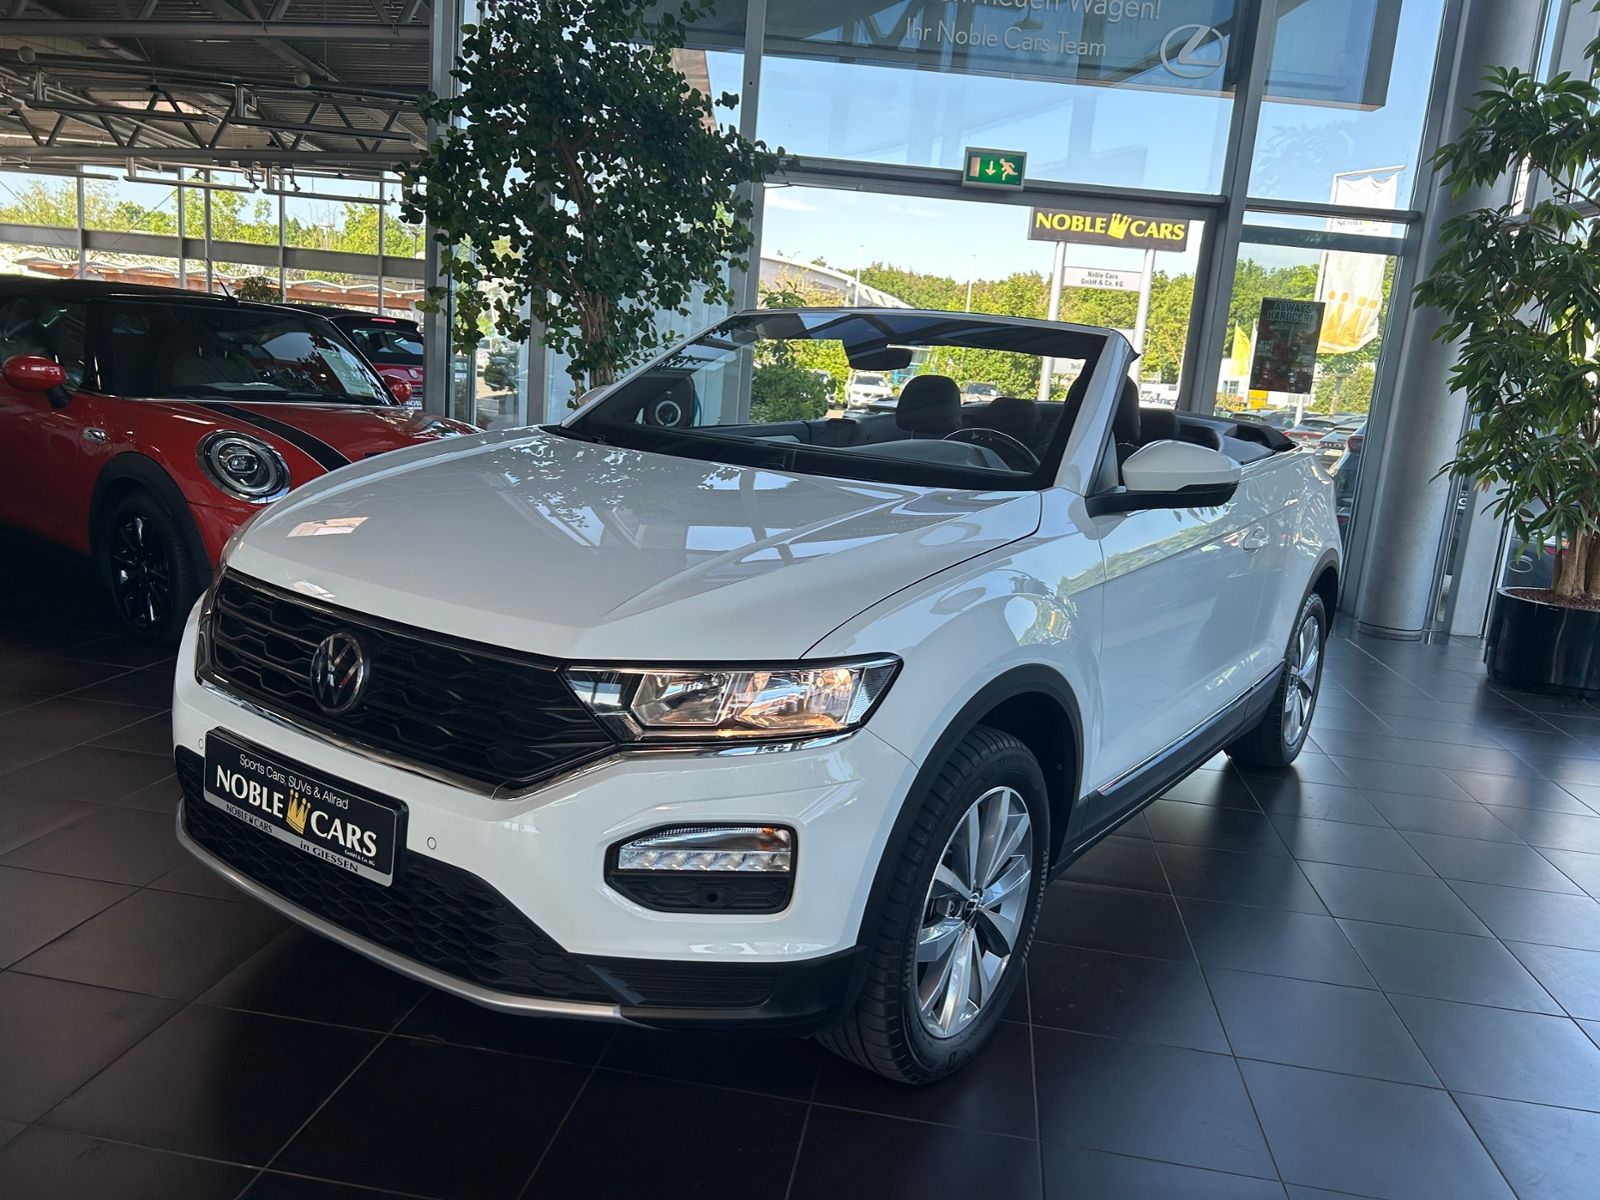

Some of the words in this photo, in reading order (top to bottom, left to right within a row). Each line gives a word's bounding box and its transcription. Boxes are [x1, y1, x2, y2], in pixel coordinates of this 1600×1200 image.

[906, 17, 931, 42] Ihr
[937, 22, 998, 48] Noble
[1004, 26, 1049, 52] Cars
[1057, 31, 1107, 57] Team
[1035, 212, 1107, 234] NOBLE
[1129, 220, 1185, 241] CARS
[1080, 278, 1097, 286] GmbH
[1087, 271, 1104, 279] Noble
[1105, 272, 1119, 280] Cars
[1266, 310, 1318, 324] HARDCORE
[1273, 301, 1313, 313] ALWAYS
[240, 754, 265, 775] Sports
[266, 766, 287, 787] Cars,
[288, 775, 312, 795] SUVs
[313, 786, 321, 799] &
[322, 790, 349, 810] Allrad
[216, 764, 284, 819] NOBLE
[310, 810, 377, 858] CARS
[226, 803, 249, 822] NOBLE
[254, 818, 273, 834] CARS
[300, 840, 310, 851] in
[312, 847, 359, 873] GIESSEN
